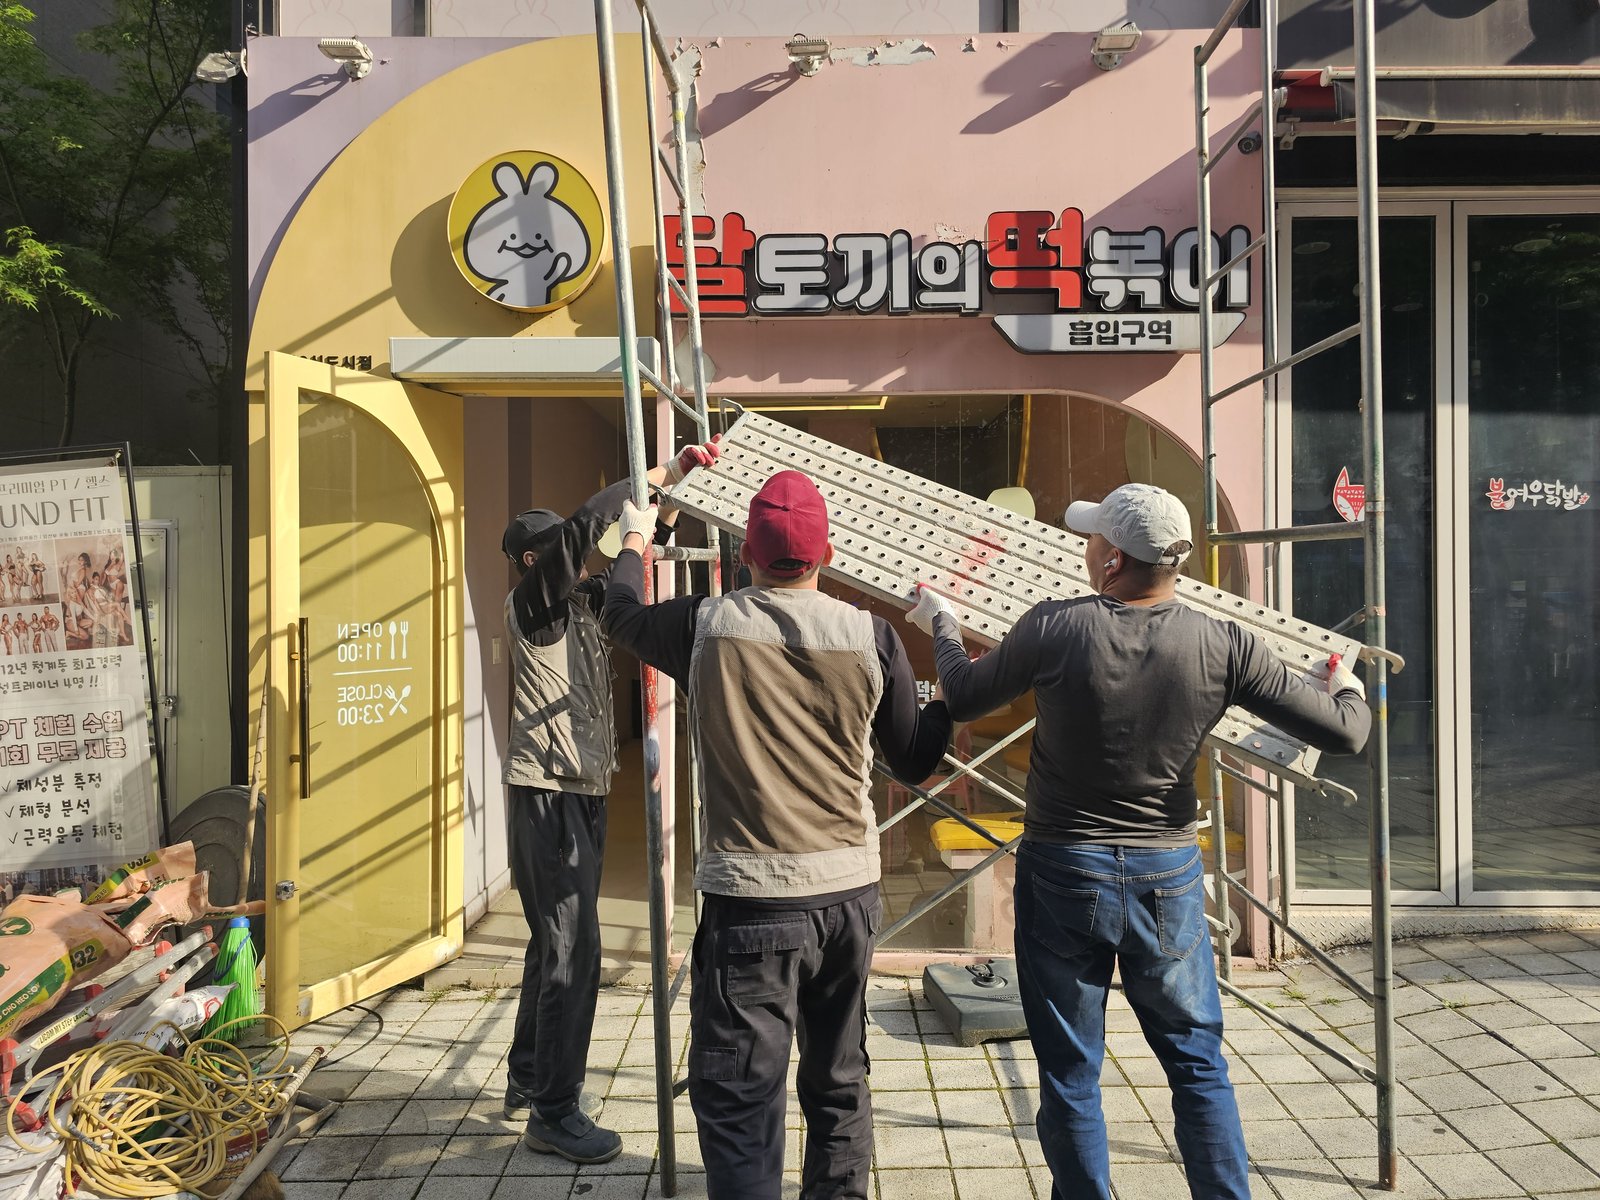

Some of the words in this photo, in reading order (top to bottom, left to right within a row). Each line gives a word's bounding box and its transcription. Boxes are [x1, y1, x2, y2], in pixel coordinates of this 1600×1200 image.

[1068, 320, 1173, 346] 흡입구역
[50, 479, 68, 492] PT
[69, 496, 110, 523] FIT
[1, 662, 27, 675] 12년
[32, 658, 67, 673] 청계동
[73, 654, 122, 671] 최고경력
[64, 677, 84, 688] 4명
[34, 714, 75, 737] 체험
[83, 711, 123, 733] 수업
[38, 740, 79, 763] 무료
[84, 737, 126, 760] 제공
[17, 774, 64, 792] 체성분
[74, 773, 102, 791] 측정
[20, 802, 51, 818] 체형
[61, 799, 90, 817] 분석
[24, 825, 84, 846] 근력운동
[92, 822, 122, 840] 체험
[72, 944, 98, 969] 32
